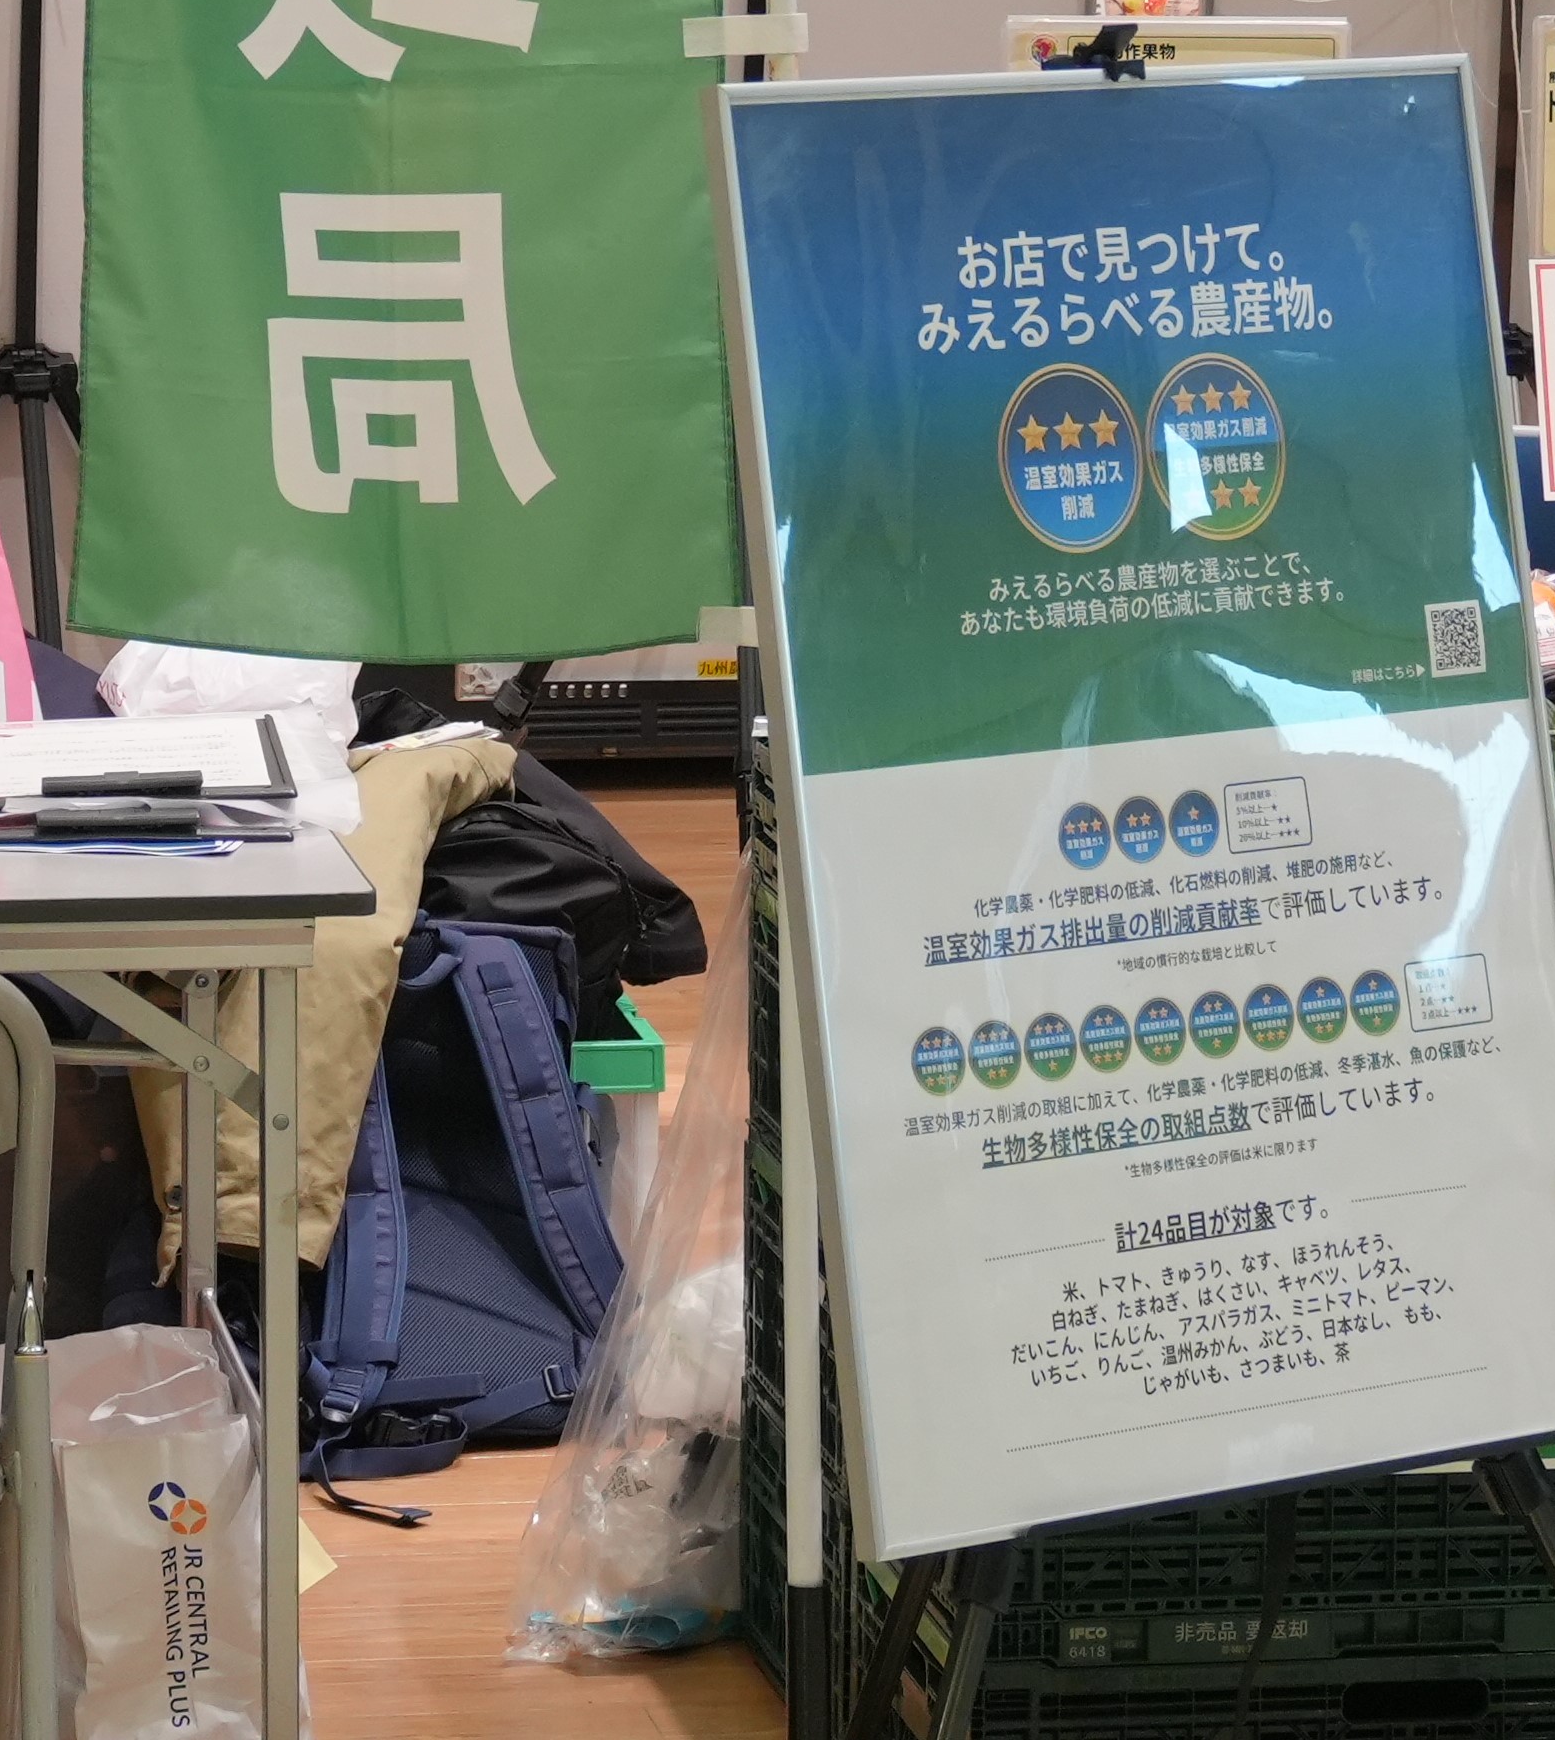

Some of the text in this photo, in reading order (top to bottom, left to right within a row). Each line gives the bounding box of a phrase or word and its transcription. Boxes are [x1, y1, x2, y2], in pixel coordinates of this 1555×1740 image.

[956, 222, 1285, 292] お店で見つけて。
[917, 276, 1335, 355] みえるらべる農産物。
[1024, 460, 1124, 492] 温室効果ガス
[1061, 495, 1096, 521] 削減
[987, 551, 1312, 602] みえるらべる農産物を選ぶことで、
[959, 578, 1346, 636] あなたも環境負荷の低減に貢献できます。
[921, 875, 1445, 967] 温室効果ガス排出量の削減貢献率で評価しています。
[981, 1076, 1436, 1170] 生物多様性保全の取組点数で評価しています。
[1114, 1193, 1331, 1254] 計24品目が対象です。
[160, 1546, 191, 1728] RETAILING PLUS
[183, 1542, 212, 1679] JR CENTRAL
[1069, 1626, 1108, 1640] IFCO
[1175, 1621, 1238, 1643] 非売品
[1068, 1645, 1107, 1658] 6418
